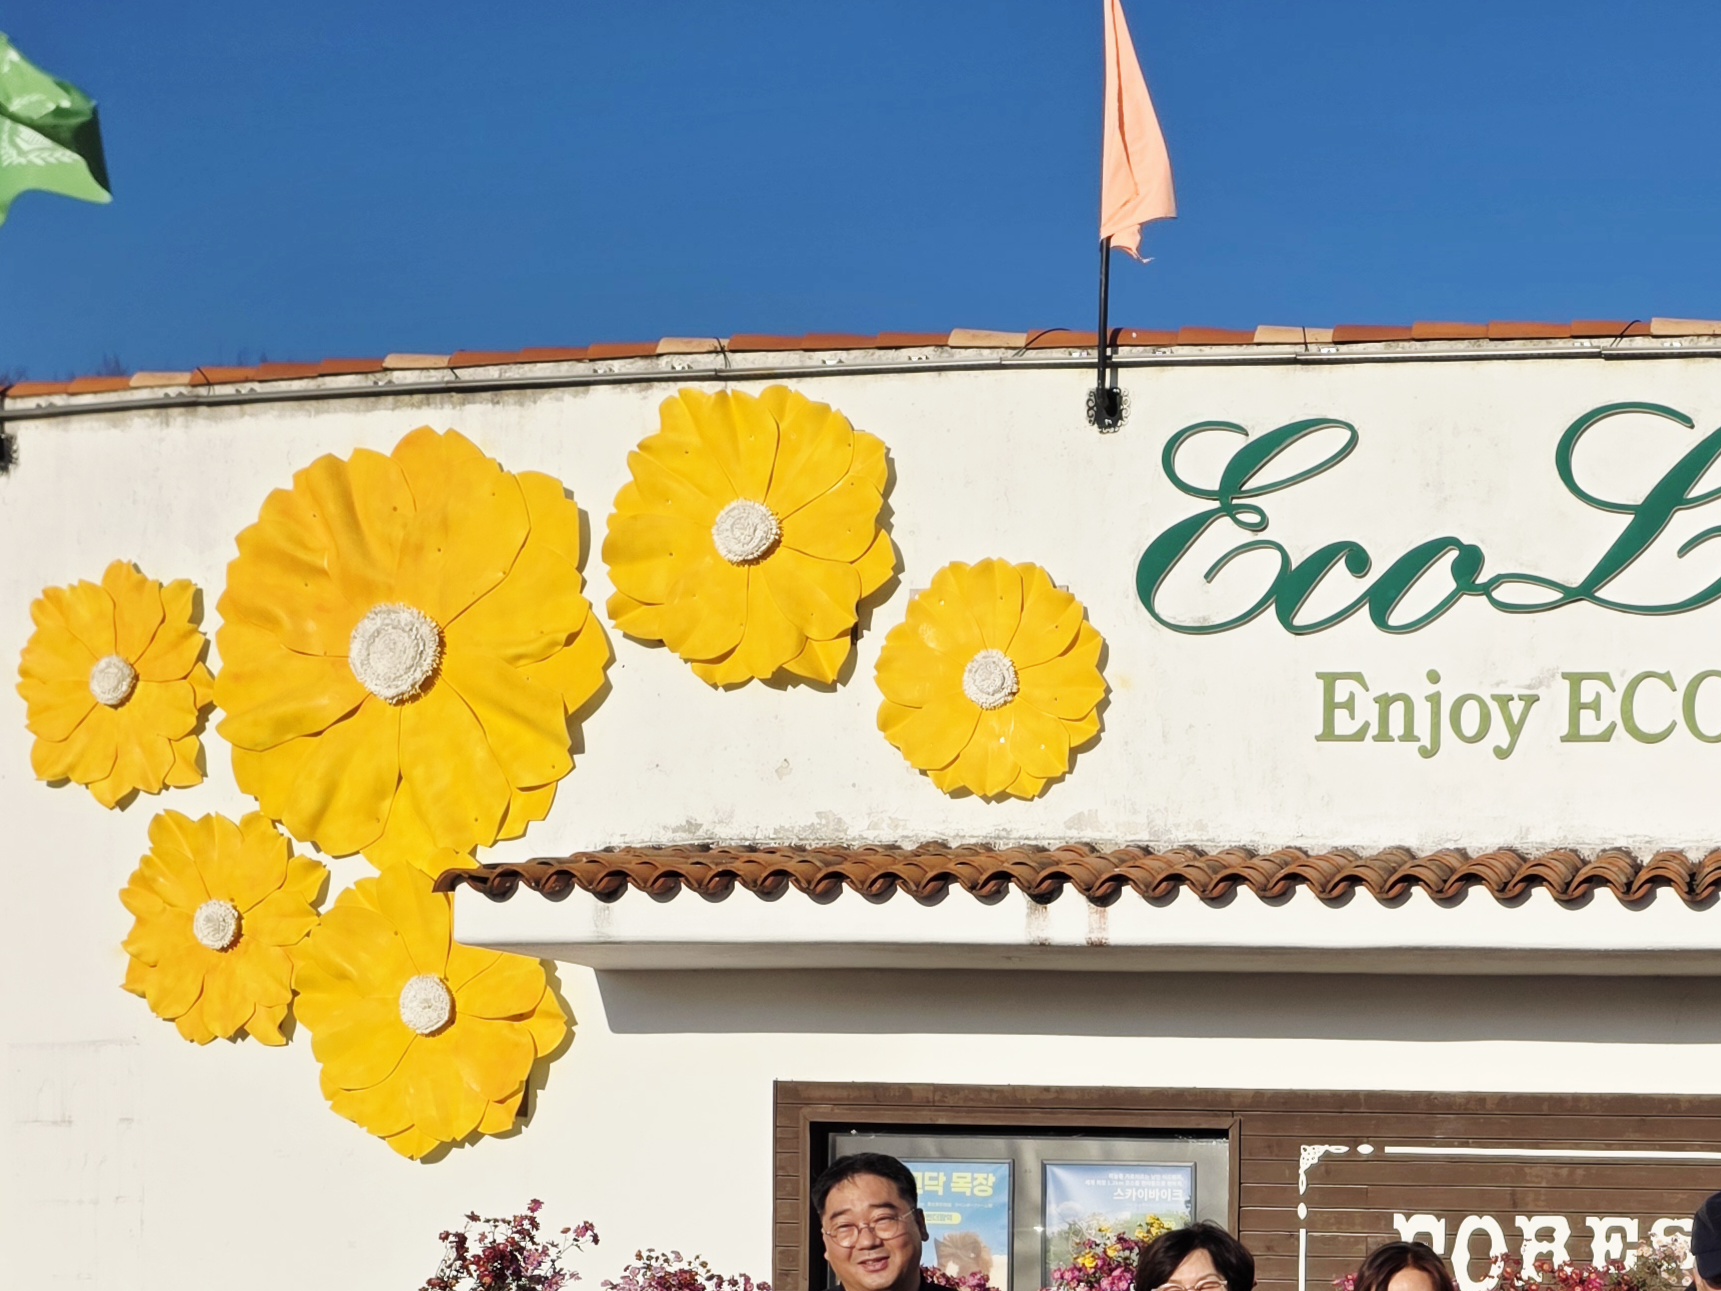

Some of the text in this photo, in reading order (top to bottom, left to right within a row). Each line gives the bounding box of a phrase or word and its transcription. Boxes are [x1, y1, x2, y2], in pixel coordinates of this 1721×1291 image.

[1314, 669, 1539, 760] Enjoy
[951, 1172, 995, 1197] 목장
[1112, 1187, 1184, 1202] 스카이바이크
